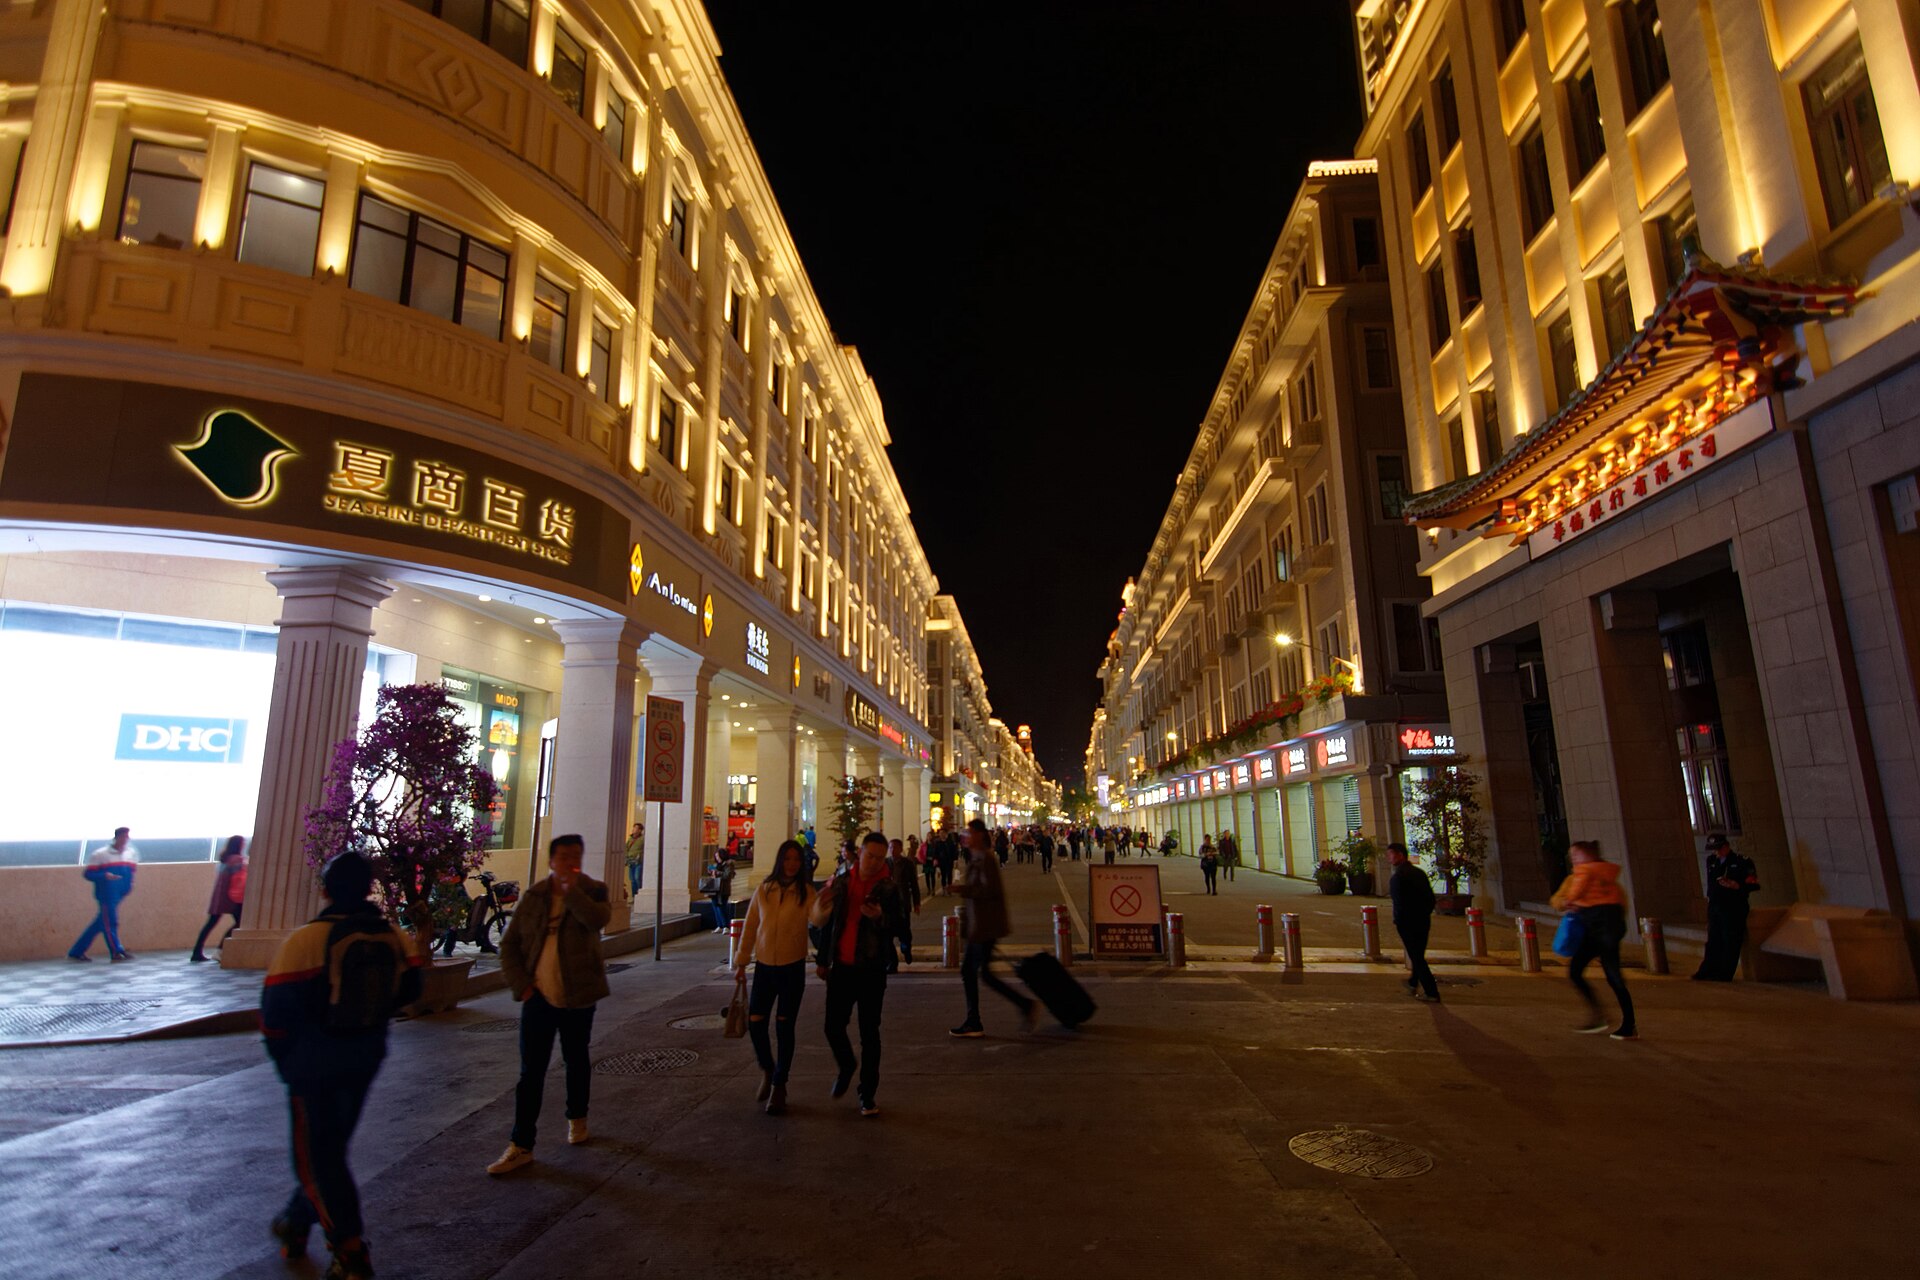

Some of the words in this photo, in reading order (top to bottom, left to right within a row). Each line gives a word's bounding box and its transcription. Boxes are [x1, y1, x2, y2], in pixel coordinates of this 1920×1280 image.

[328, 440, 577, 548] 夏商百货
[324, 494, 423, 525] SEASHINE
[423, 511, 527, 553] DEPARTMENT
[444, 677, 473, 692] TISSOT
[495, 693, 519, 708] MIDO
[132, 724, 232, 753] DHC
